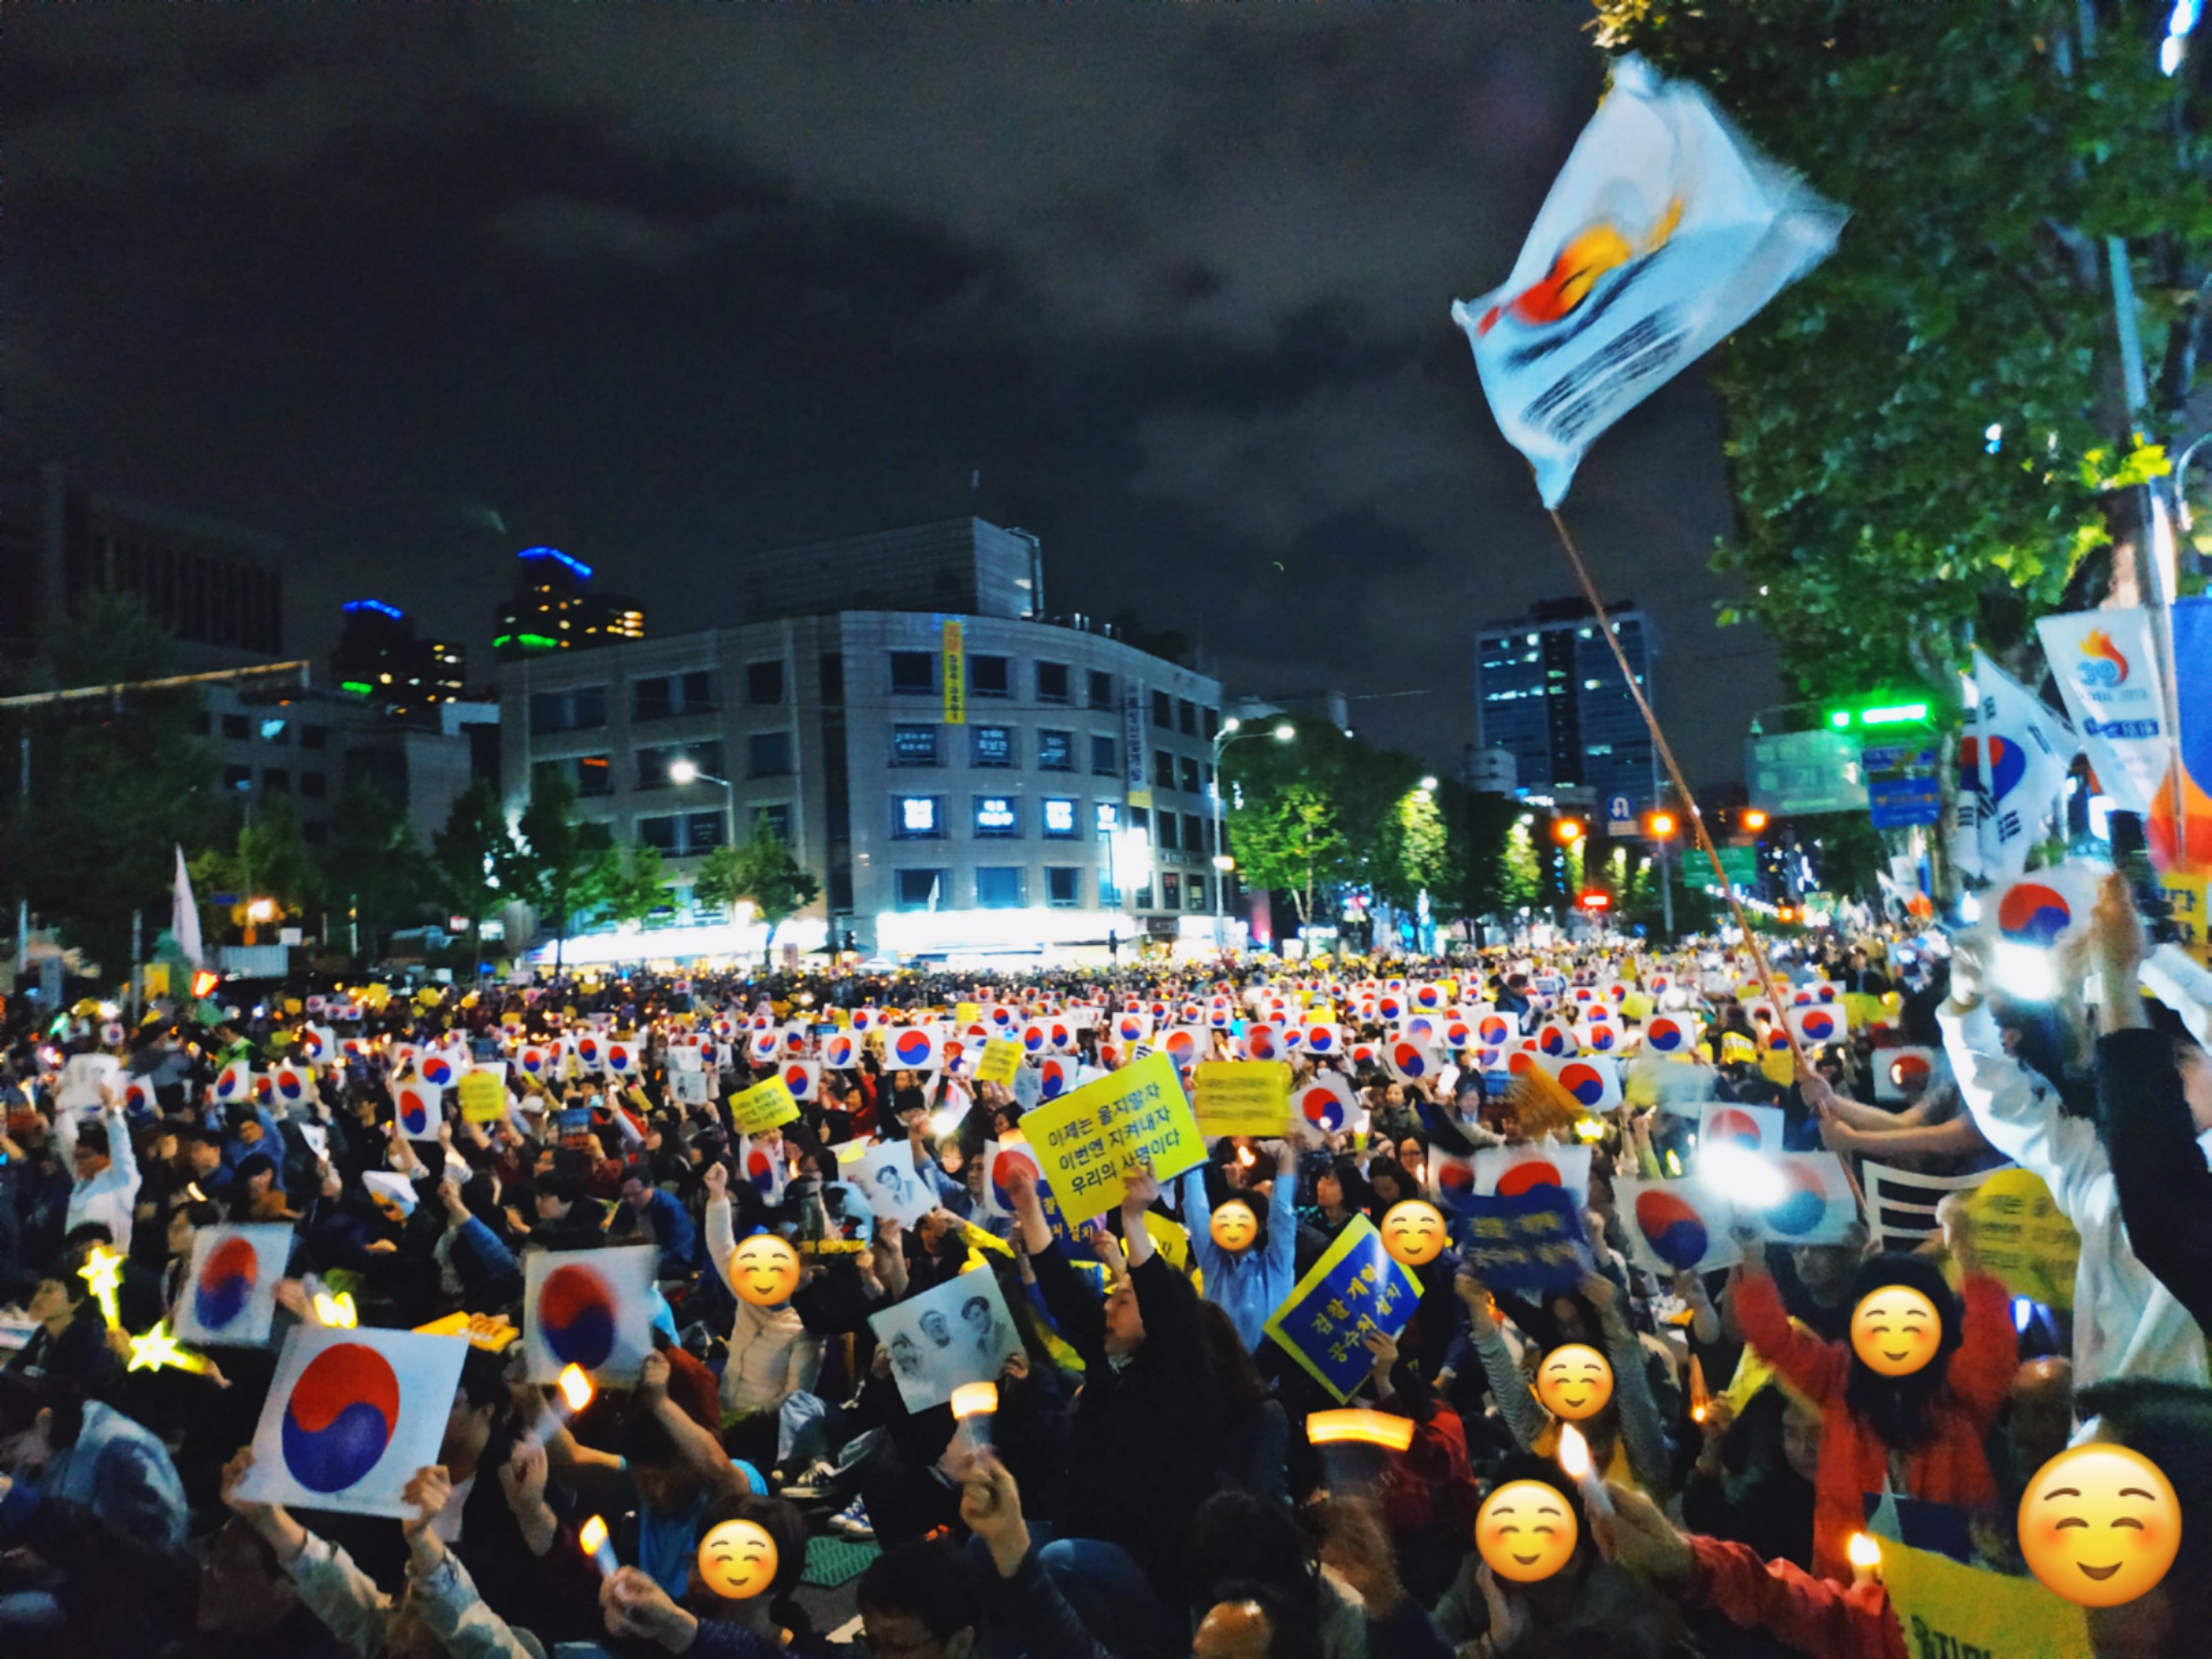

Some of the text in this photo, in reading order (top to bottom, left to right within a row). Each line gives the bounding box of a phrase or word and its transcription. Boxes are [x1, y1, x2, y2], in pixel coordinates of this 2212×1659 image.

[1048, 1081, 1160, 1147] 이제는 울지말자
[1059, 1105, 1170, 1170] 이번엔 지켜내자
[1071, 1128, 1180, 1196] 우리의 사명이다
[1311, 1297, 1351, 1335] 검찰
[1327, 1282, 1403, 1363] 공수처 설치
